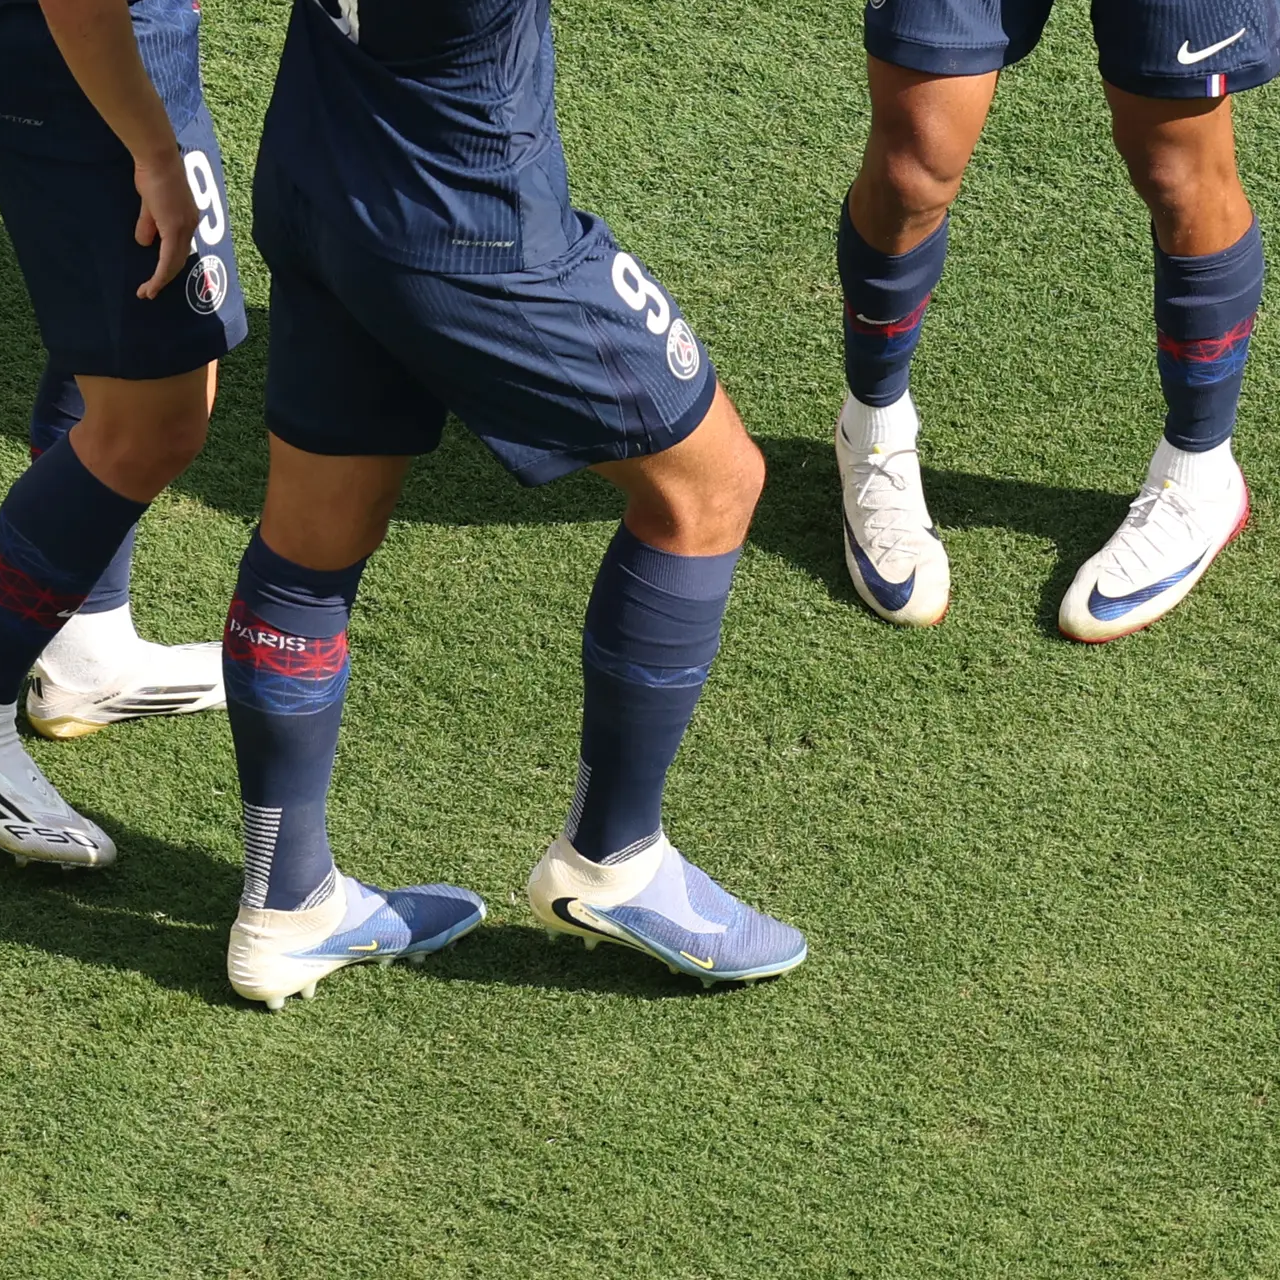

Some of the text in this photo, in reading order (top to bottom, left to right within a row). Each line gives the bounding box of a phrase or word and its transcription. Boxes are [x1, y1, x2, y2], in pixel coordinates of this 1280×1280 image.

[183, 150, 225, 253] 9
[611, 251, 670, 335] 9
[229, 618, 307, 653] PARIS
[3, 824, 100, 850] F50
